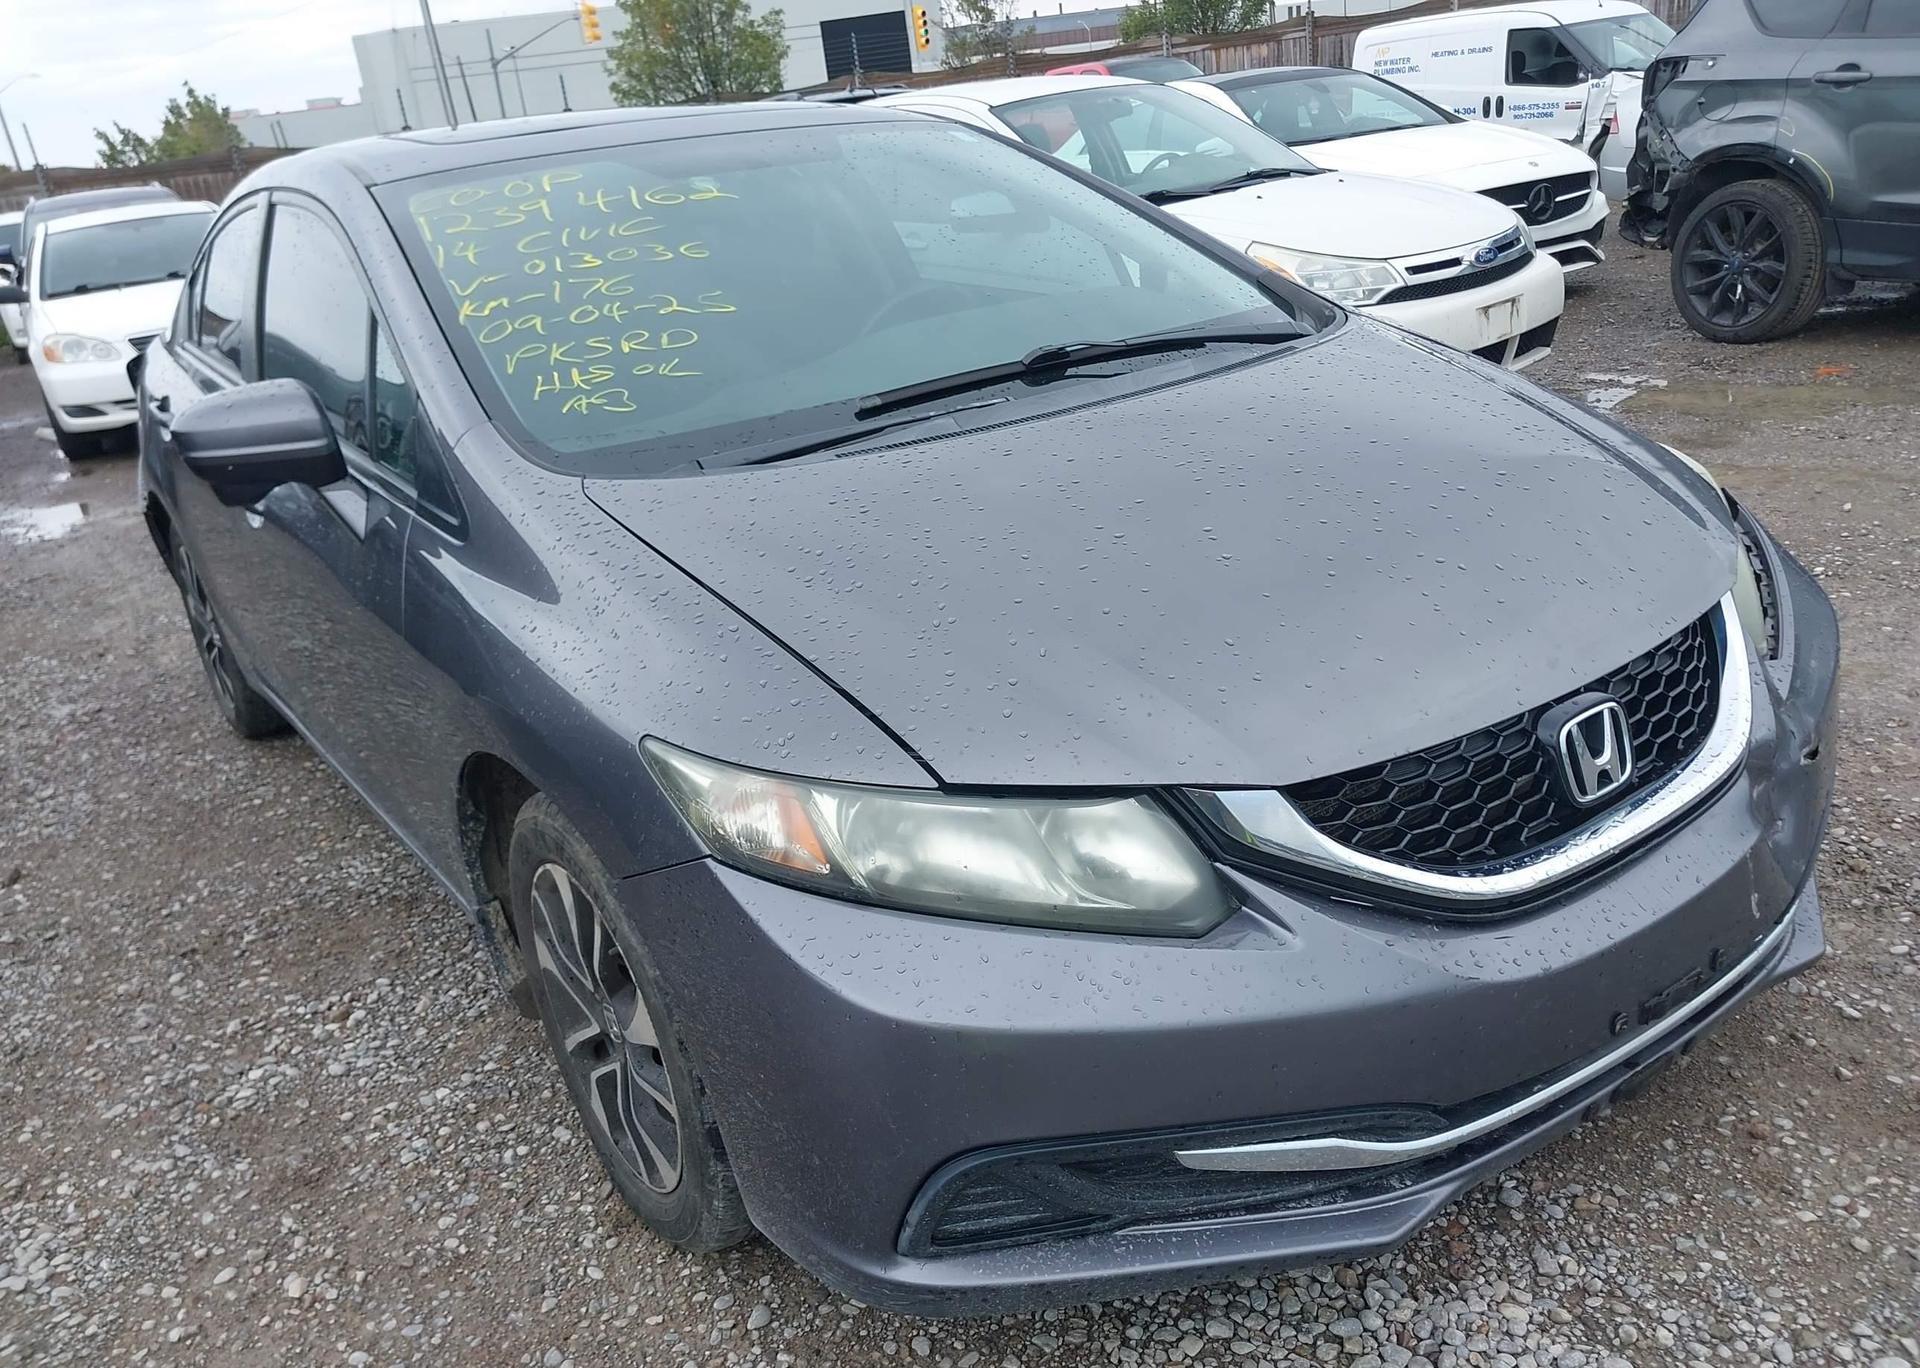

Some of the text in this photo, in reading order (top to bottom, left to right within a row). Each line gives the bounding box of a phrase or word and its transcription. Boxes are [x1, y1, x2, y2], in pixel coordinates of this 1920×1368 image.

[1431, 49, 1459, 58] HEATING
[1467, 46, 1494, 55] DRAINS
[1374, 57, 1412, 68] NEW WATER
[1373, 65, 1421, 77] PLUMBING INC.
[437, 216, 667, 270] 14 CIVIC
[1479, 249, 1495, 262] Ford
